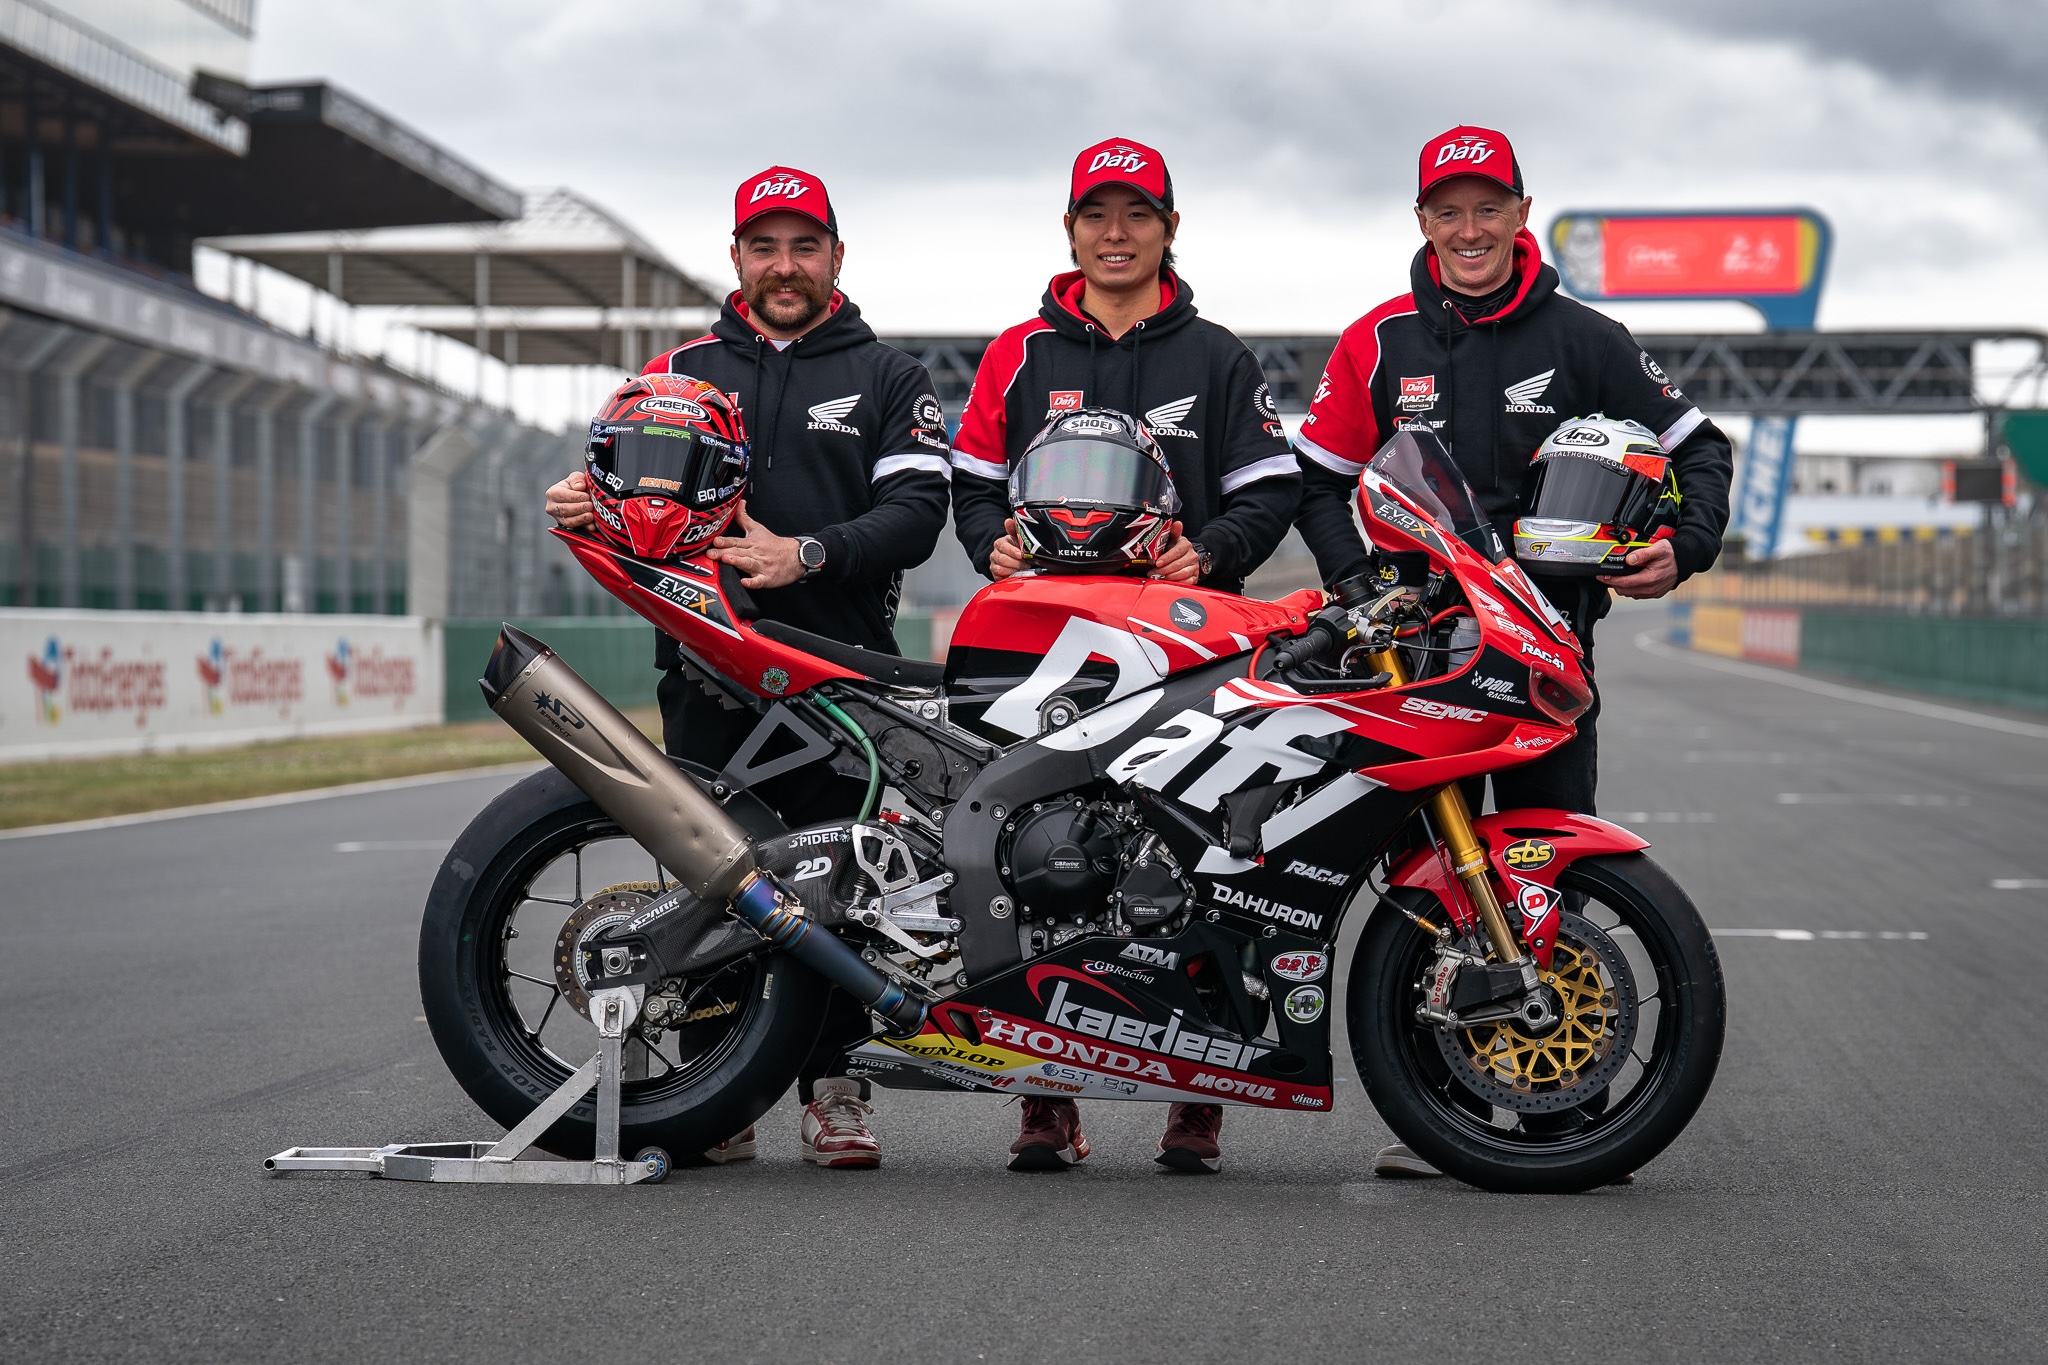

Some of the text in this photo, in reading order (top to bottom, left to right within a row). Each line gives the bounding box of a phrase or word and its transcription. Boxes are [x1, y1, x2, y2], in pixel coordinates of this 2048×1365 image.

[1088, 151, 1148, 174] Dafy
[1434, 142, 1495, 168] Dafy
[750, 180, 809, 204] Dafy
[1405, 382, 1430, 393] Dafy
[645, 400, 701, 416] CABERG
[1053, 396, 1078, 408] Dafy
[1505, 404, 1556, 414] HONDA
[807, 421, 861, 437] HONDA
[1071, 419, 1113, 431] SHOEI
[1146, 427, 1199, 439] HONDA
[1562, 428, 1604, 443] Arai
[605, 472, 624, 491] BQ
[638, 477, 682, 491] NEWTON
[697, 488, 716, 503] BQ
[1375, 510, 1411, 530] RACING
[1379, 503, 1432, 539] EVO-X
[1058, 549, 1099, 558] KENTEX
[653, 585, 690, 606] RACING
[657, 576, 717, 615] EVO-X
[1174, 617, 1202, 627] HONDA
[1401, 697, 1488, 723] SEMC
[788, 831, 839, 849] SPIDER
[1507, 839, 1551, 864] sbs
[793, 856, 833, 882] 2D
[1281, 859, 1350, 887] RAC41
[1211, 881, 1323, 931] DAHURON
[1119, 942, 1181, 971] ATM
[1276, 957, 1302, 972] S2
[1094, 960, 1155, 985] GBRacing
[1431, 966, 1449, 1004] brembo
[901, 1043, 1006, 1067] DUNLOP
[984, 1016, 1177, 1083] HONDA
[849, 1056, 896, 1070] SPIDER
[930, 1060, 999, 1082] Andreani
[1023, 1075, 1085, 1094] NEWTON
[1059, 1068, 1094, 1084] S.T.
[826, 1084, 853, 1093] PRADA
[1101, 1077, 1139, 1096] BQ
[1189, 1072, 1276, 1100] MOTUL
